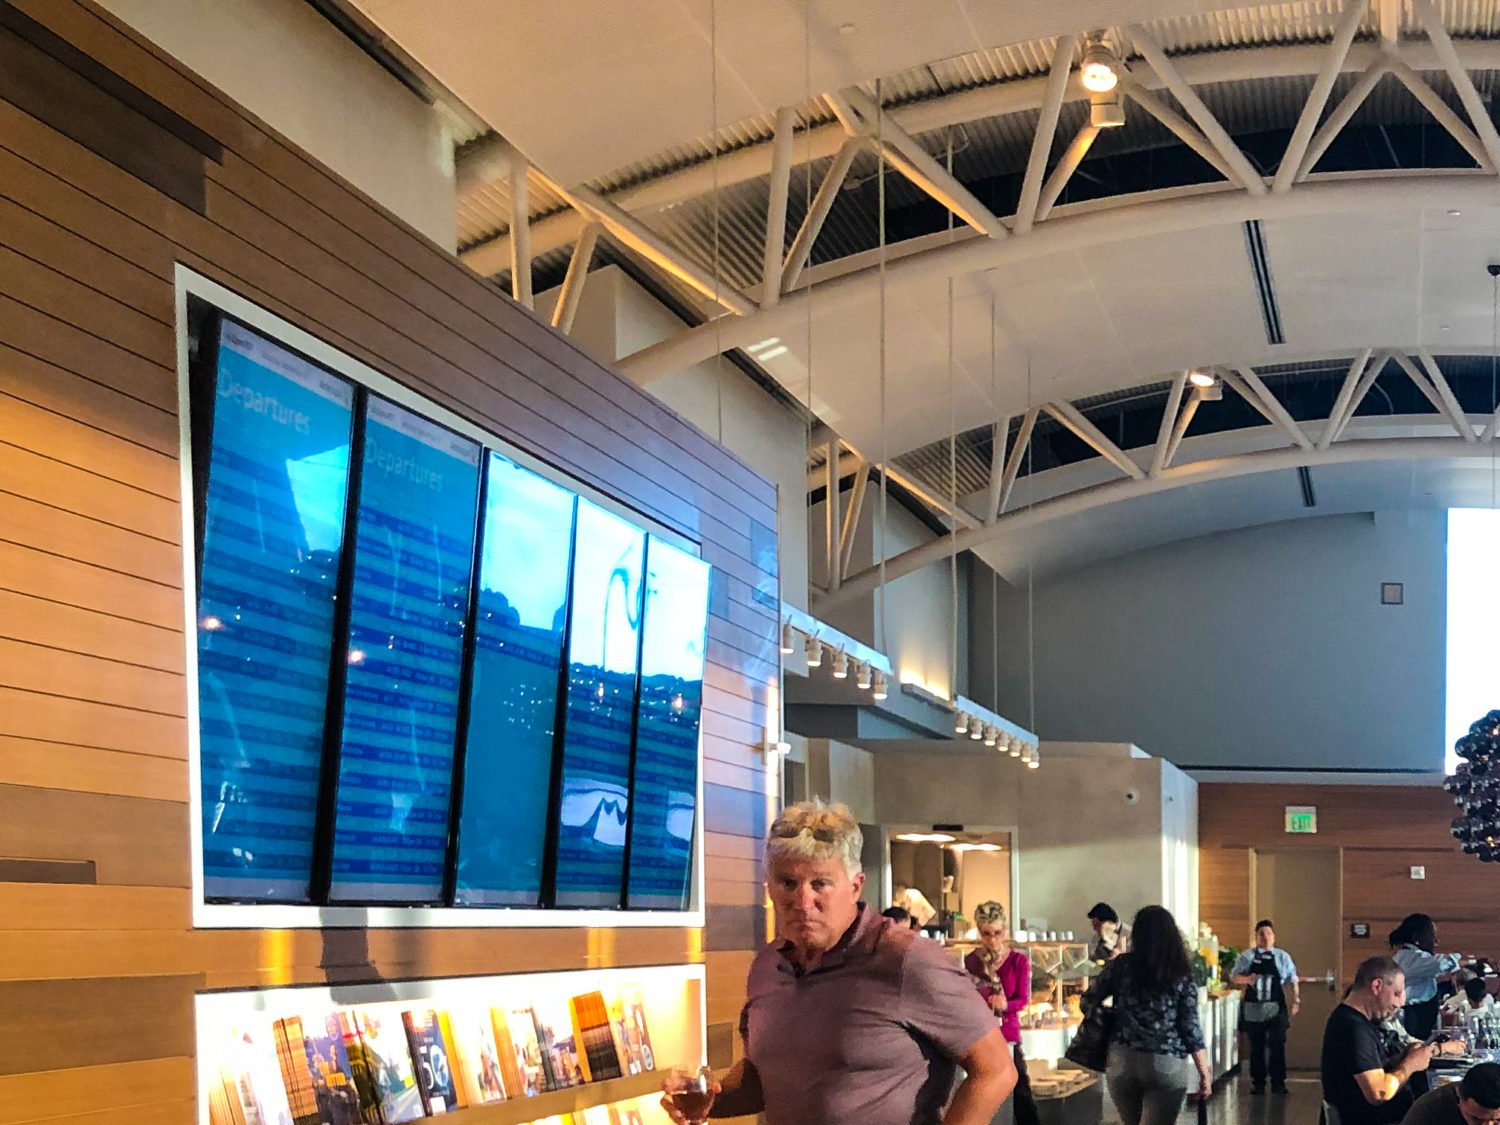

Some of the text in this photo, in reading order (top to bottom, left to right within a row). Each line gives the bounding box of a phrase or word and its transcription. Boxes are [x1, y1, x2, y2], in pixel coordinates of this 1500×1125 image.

[216, 367, 312, 436] Departures
[365, 437, 445, 493] Departures
[1291, 814, 1312, 832] EXIT
